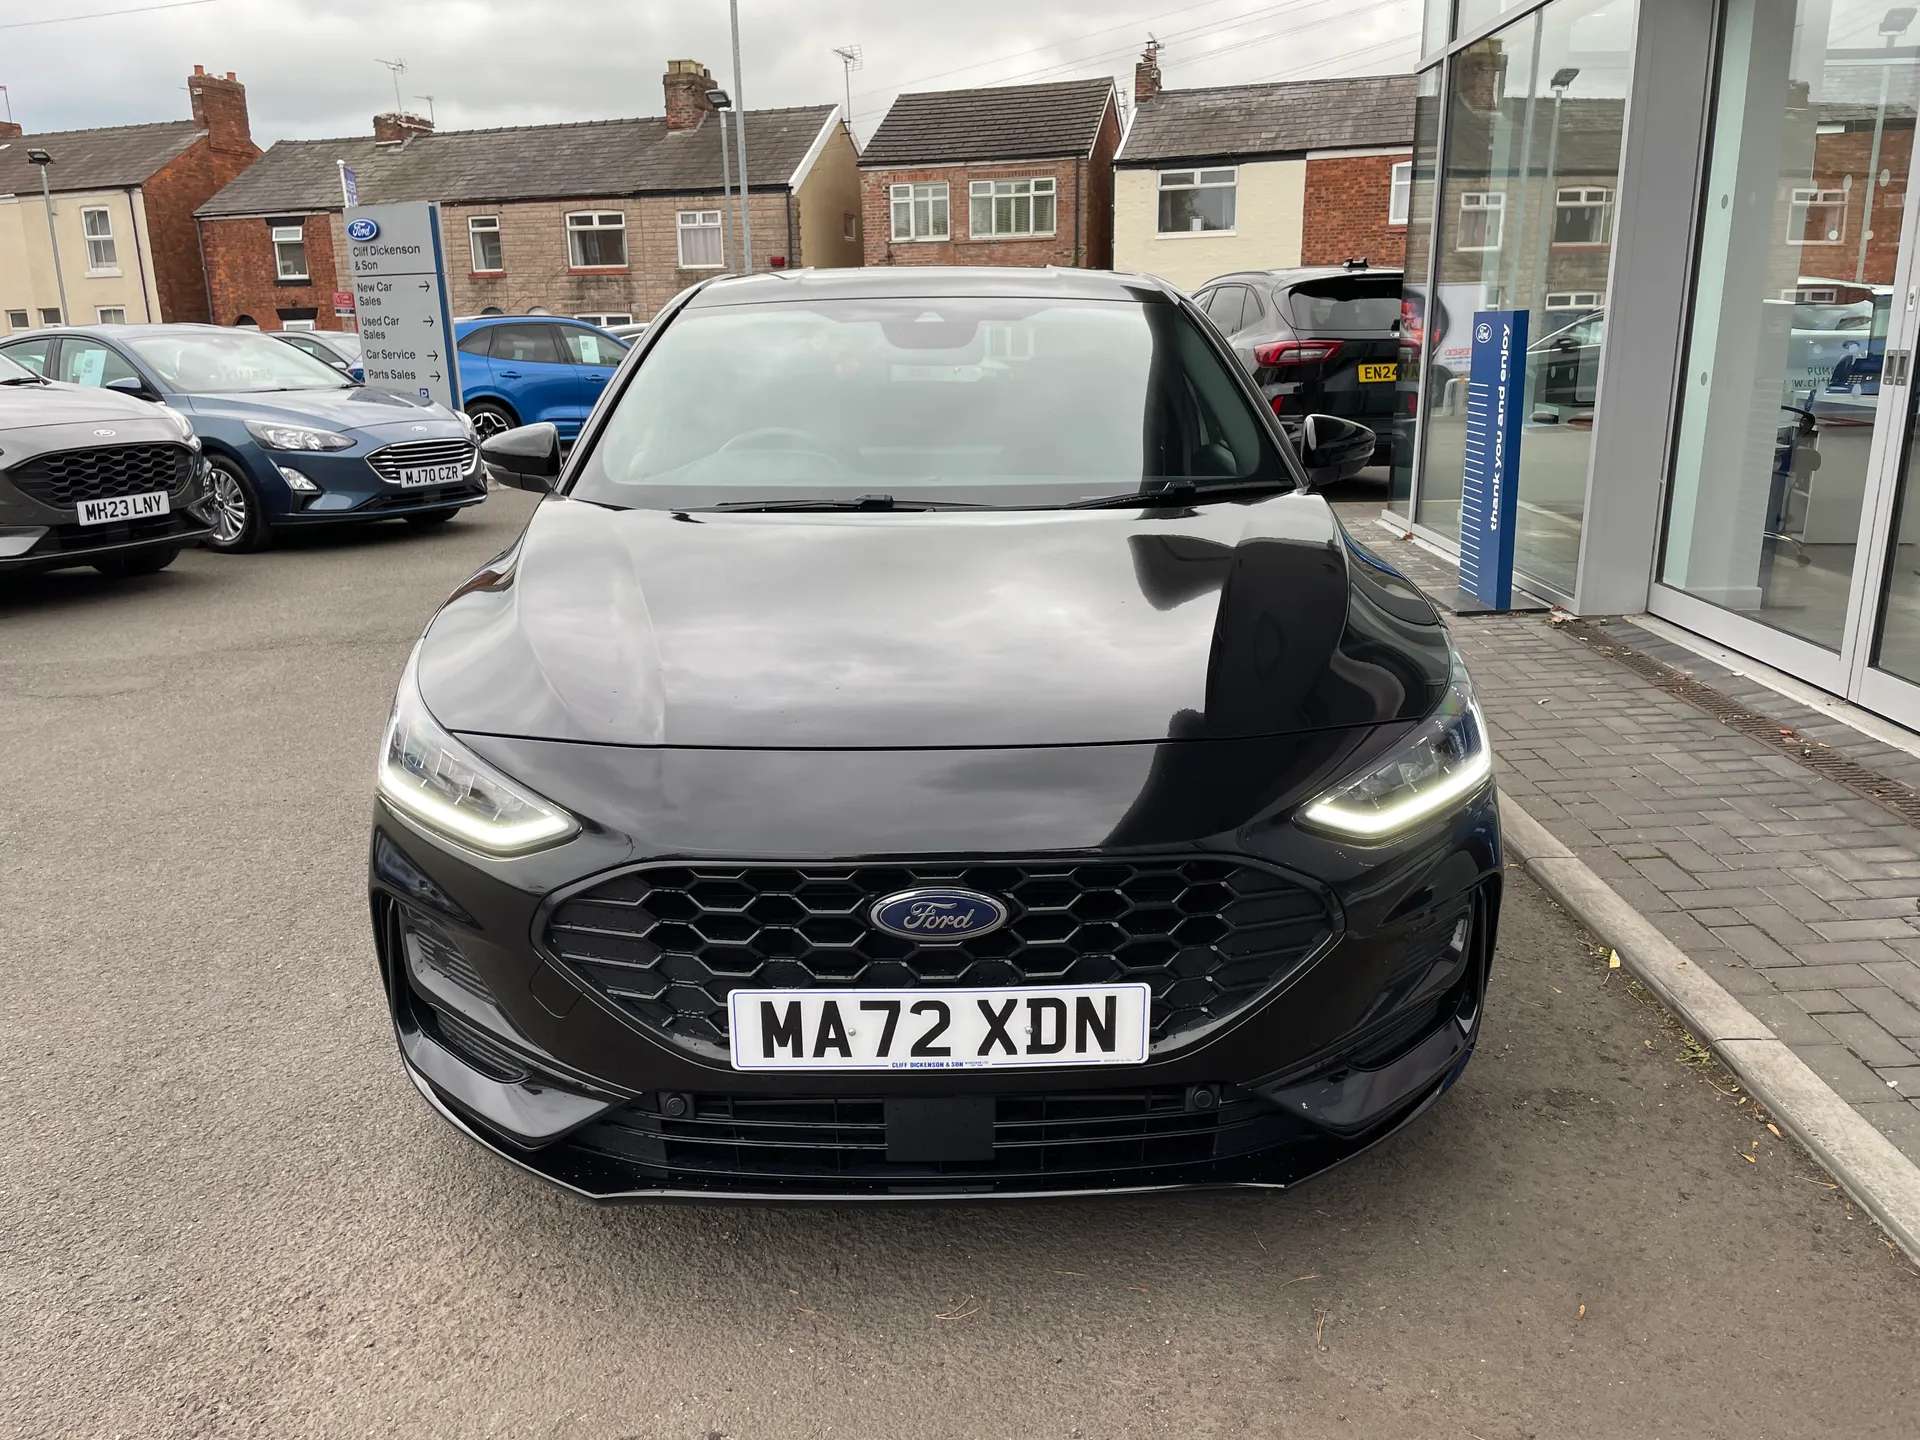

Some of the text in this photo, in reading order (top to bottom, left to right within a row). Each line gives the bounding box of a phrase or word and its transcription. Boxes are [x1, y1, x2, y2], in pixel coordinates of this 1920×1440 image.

[352, 222, 371, 237] Ford
[353, 244, 421, 257] Cliff Dickenson
[354, 260, 378, 271] & Son
[357, 281, 392, 293] New Car
[359, 296, 382, 306] Sales
[362, 315, 400, 326] Used Car
[363, 329, 386, 340] Sales
[366, 348, 416, 360] Car Service
[368, 368, 416, 380] Parts Sales
[1490, 323, 1510, 531] thank you and enjoy
[405, 465, 459, 485] MJ70 CZR
[85, 495, 161, 521] MH23 LNY
[903, 901, 975, 929] Ford
[760, 995, 1118, 1059] MA72 XDN
